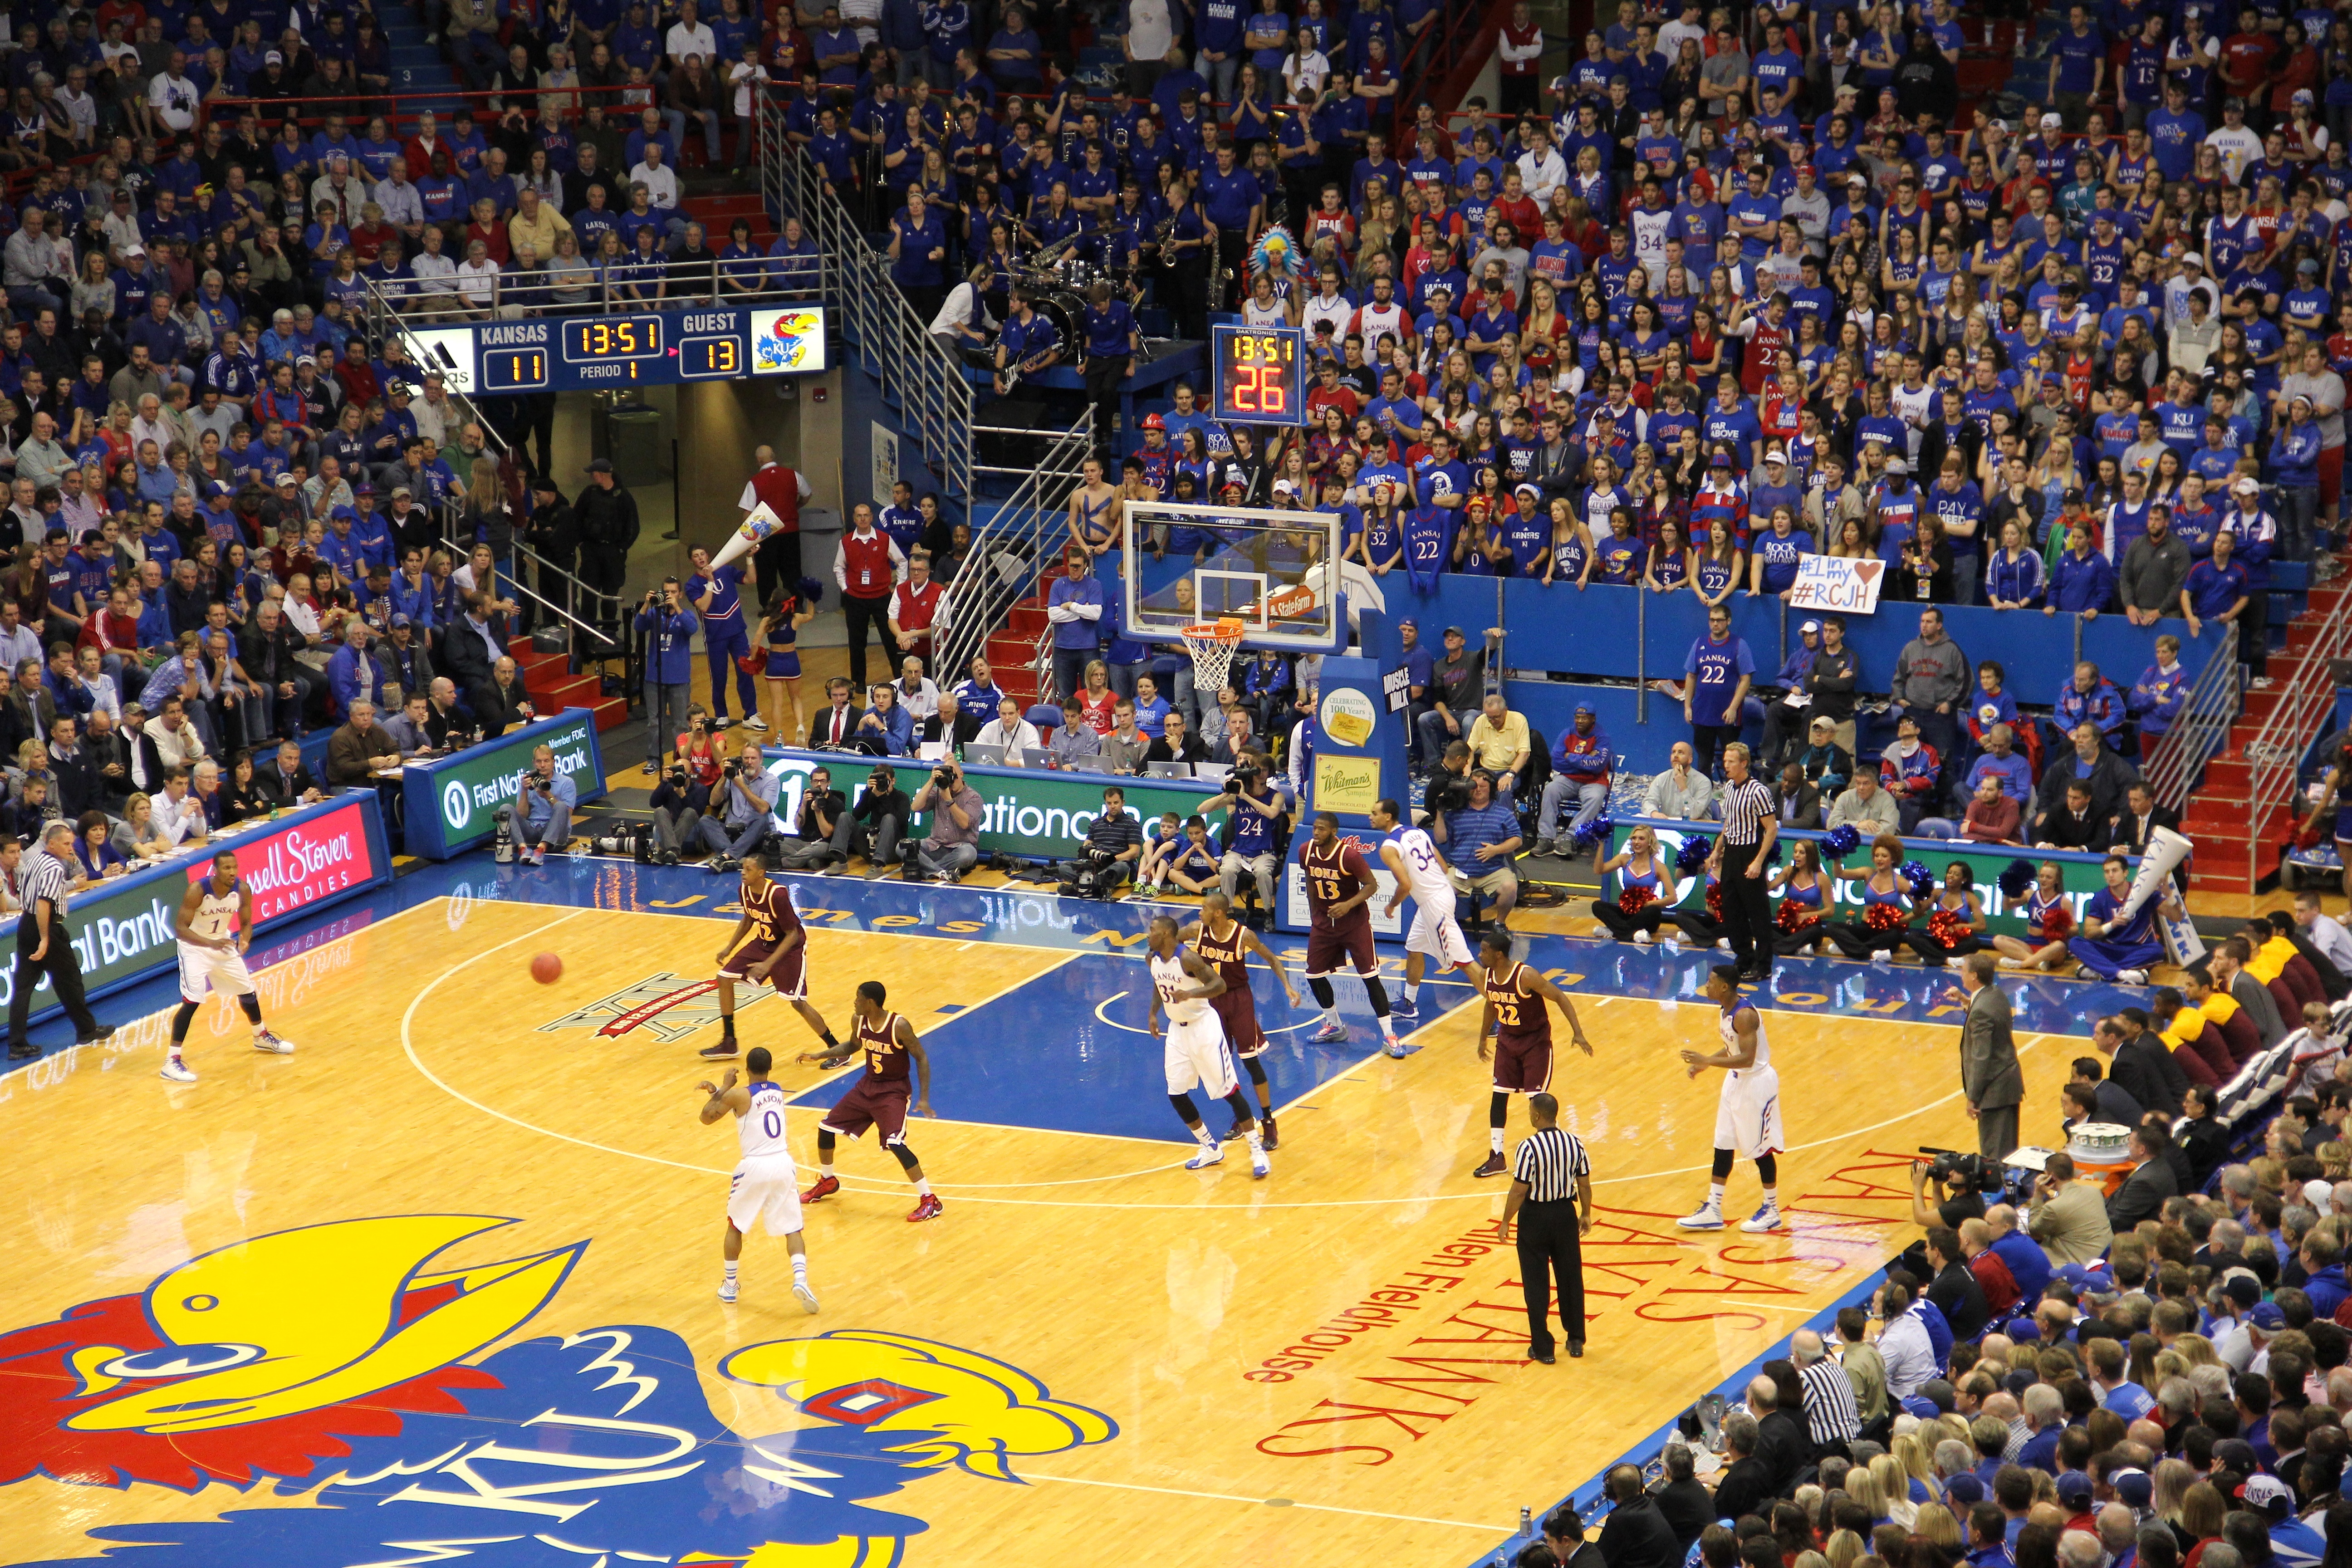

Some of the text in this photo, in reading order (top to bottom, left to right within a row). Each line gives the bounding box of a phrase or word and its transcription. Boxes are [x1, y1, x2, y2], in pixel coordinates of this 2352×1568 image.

[403, 69, 411, 81] 3
[1759, 65, 1786, 75] STATE
[2138, 68, 2154, 84] 15
[426, 191, 451, 200] KANSAS
[585, 220, 609, 230] KANSAS
[1639, 224, 1666, 233] KANSAS
[1640, 235, 1664, 251] 34
[1536, 255, 1566, 272] CRIMSON
[2091, 255, 2120, 264] KANSAS
[2217, 247, 2229, 264] 4
[2094, 265, 2114, 283] 32
[1425, 283, 1452, 291] KANSAS
[683, 313, 736, 333] GUEST
[1365, 324, 1395, 333] KANSAS
[481, 324, 547, 345] KANSAS
[583, 323, 656, 353] 13:51
[772, 343, 789, 356] KU
[1235, 336, 1292, 361] 13:51
[2247, 339, 2262, 348] OVE
[707, 341, 734, 370] 13
[513, 355, 540, 381] 11
[580, 362, 637, 378] PERIOD 1
[1234, 365, 1284, 411] 26
[2074, 388, 2084, 402] 4
[2172, 413, 2193, 425] KU
[1861, 432, 1893, 444] KANSAS
[1510, 450, 1533, 459] ONLY
[1939, 501, 1966, 514] PAY
[1370, 531, 1388, 546] 32
[1411, 532, 1441, 540] KANSAS
[1511, 531, 1540, 539] KANSAS
[1416, 542, 1439, 560] 22
[1764, 549, 1797, 560] CHALK
[1765, 542, 1795, 552] ROCK
[1702, 566, 1729, 575] KANSAS
[1799, 556, 1841, 577] #1 in
[1663, 572, 1670, 585] 5
[1706, 574, 1725, 589] 22
[1827, 567, 1852, 586] my
[1794, 583, 1868, 608] #RCJH
[1699, 654, 1732, 665] KANSAS
[1383, 666, 1410, 695] MUSCLE
[1702, 666, 1725, 684] 22
[1328, 697, 1367, 706] CELEBRATING
[1390, 688, 1409, 712] MILK
[1330, 706, 1366, 715] 100 Years
[548, 728, 586, 749] Member FDIC
[1617, 754, 1624, 767] 7
[473, 782, 499, 809] First
[554, 750, 587, 773] Bank
[1321, 771, 1372, 793] Whitman's
[1345, 789, 1373, 798] Sampler
[1239, 818, 1264, 836] 24
[287, 832, 352, 883] Stover
[1410, 840, 1436, 872] 34
[1309, 866, 1341, 880] IONA
[261, 871, 348, 917] CANDIES
[1315, 880, 1341, 899] 13
[96, 899, 176, 965] Bank
[209, 920, 220, 934] 1
[1200, 947, 1235, 963] IONA
[1488, 990, 1519, 1004] IONA
[1494, 1005, 1520, 1025] 22
[858, 1037, 891, 1054] IONA
[871, 1052, 882, 1075] 5
[755, 1095, 782, 1108] MASON
[763, 1110, 779, 1138] 0
[1245, 1271, 1451, 1384] Fieldhouse
[380, 1408, 704, 1523] KU
